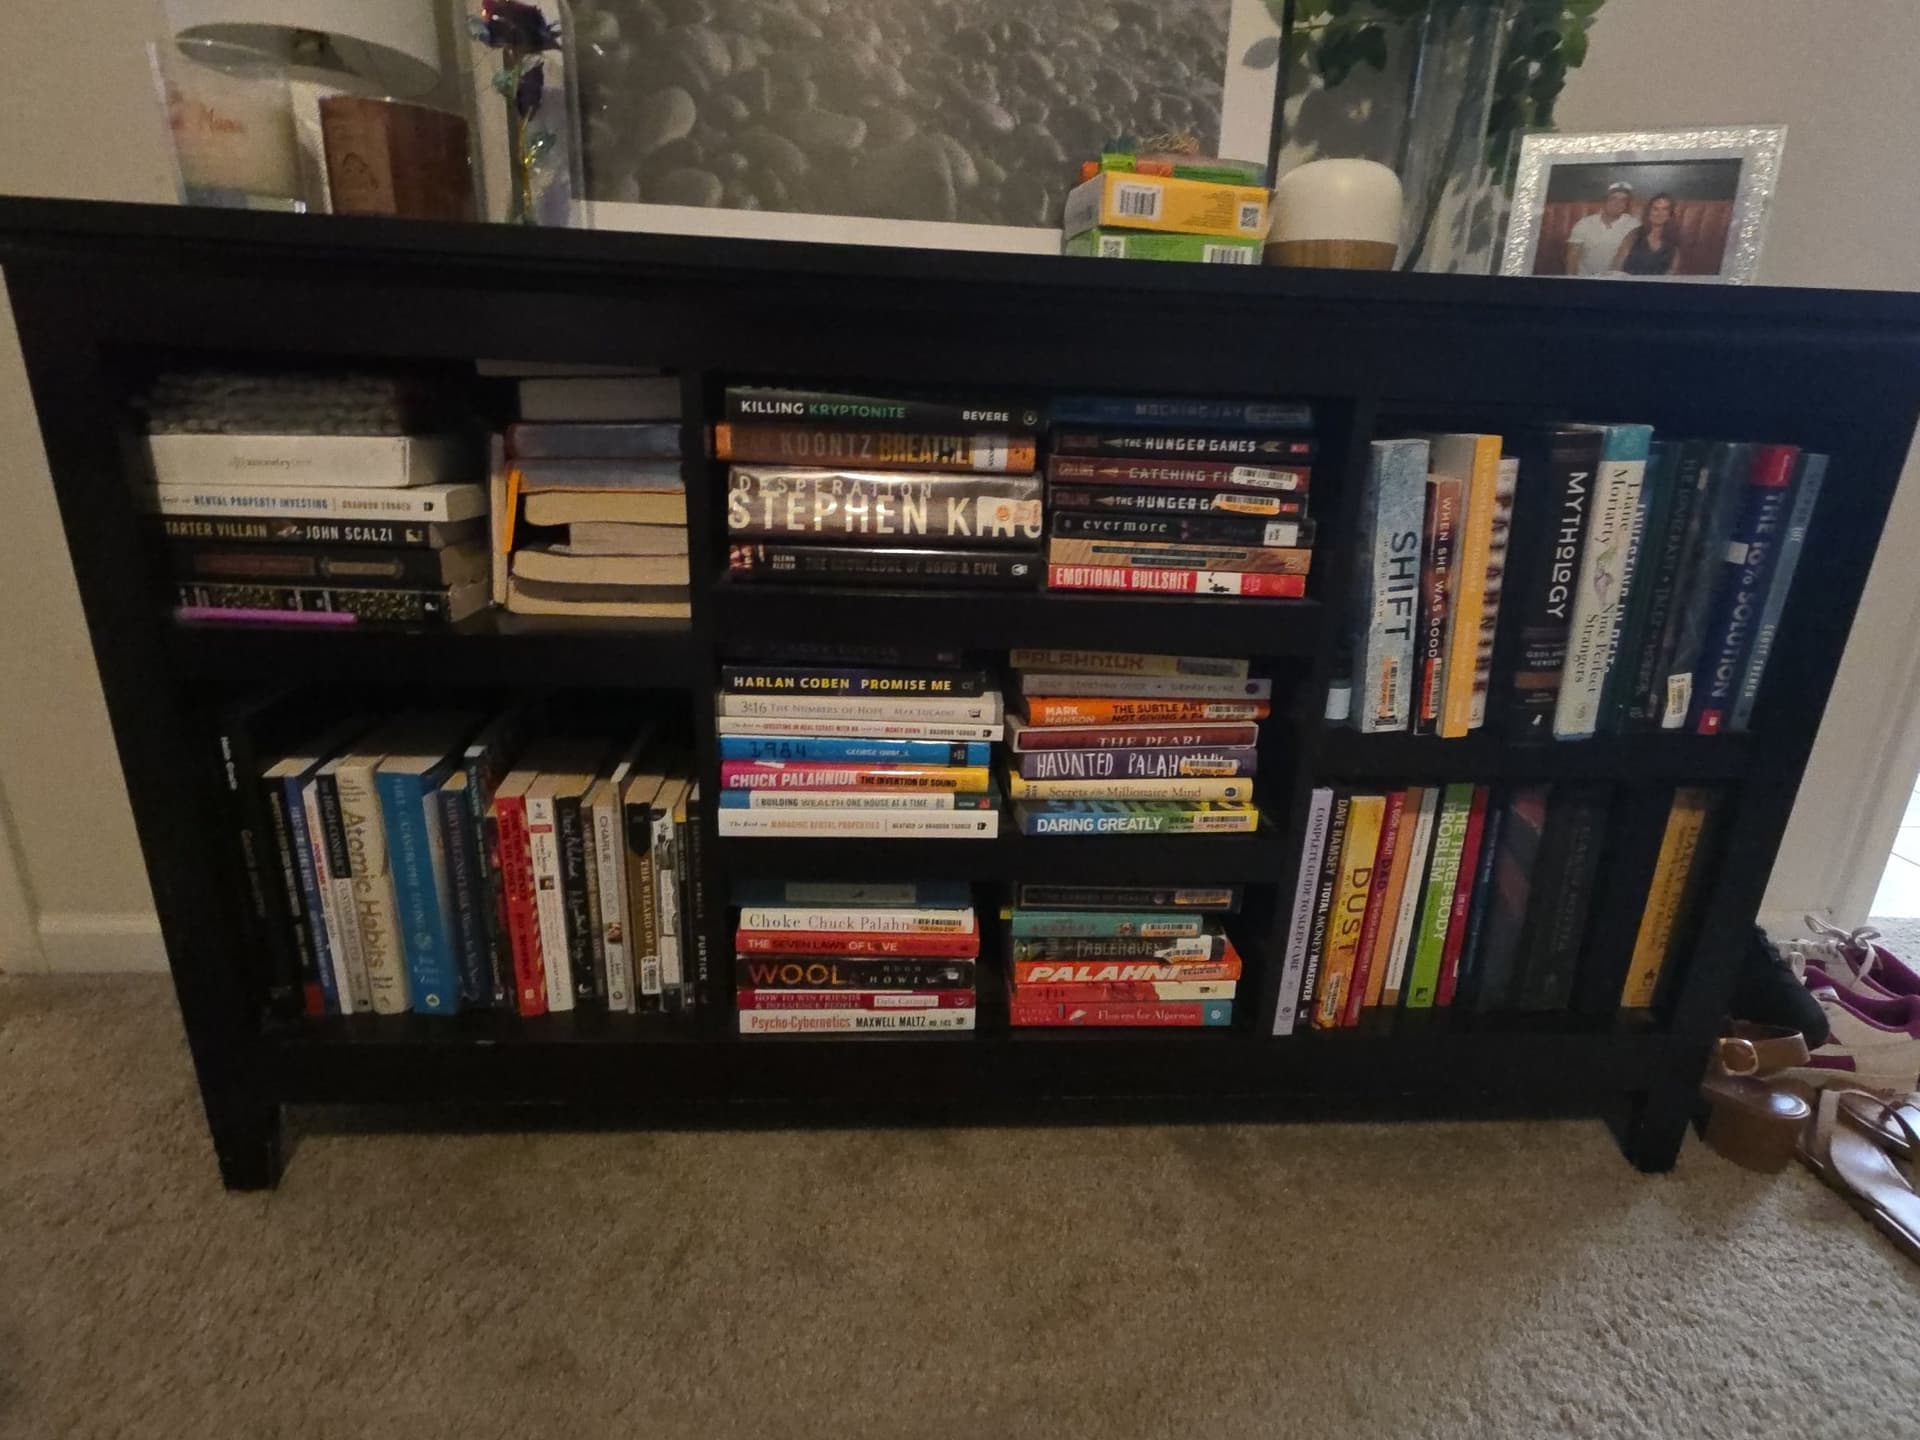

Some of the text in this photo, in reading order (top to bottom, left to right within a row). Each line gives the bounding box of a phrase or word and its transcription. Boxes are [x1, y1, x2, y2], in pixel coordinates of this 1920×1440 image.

[740, 400, 906, 418] KILLING KRYPTONITE
[961, 408, 1010, 423] BEVERE
[780, 433, 873, 459] KOONTZ
[1144, 437, 1209, 452] HUNGER
[1210, 438, 1257, 453] GAMES
[1128, 466, 1207, 482] CATCHING
[727, 487, 928, 536] STEPHEN
[1136, 495, 1198, 510] HUNGER
[1591, 468, 1640, 546] Liane Moriarty
[164, 521, 268, 537] TARTER VILLAIN
[306, 524, 393, 543] JOHN SCALZI
[1082, 518, 1169, 534] evermore
[1544, 471, 1589, 619] MYTHOLOGY
[973, 560, 1000, 576] EVIL
[1428, 496, 1451, 658] WHEN SHE WAS GOOD
[1055, 567, 1191, 591] EMOTIONAL BULLSHIT
[1383, 530, 1417, 641] SHIFT
[1710, 491, 1784, 697] THE 10% SOLUTION
[1570, 604, 1615, 692] Nine Perfect Strangers
[733, 676, 851, 691] HARLAN COBEN
[860, 678, 952, 692] PROMISE ME
[740, 700, 768, 715] 3:16
[1045, 706, 1080, 715] MARK
[1112, 704, 1134, 714] THE
[1136, 704, 1179, 714] SUBTLE
[1111, 713, 1190, 723] NOT GIVING A
[750, 742, 808, 758] 1984
[845, 748, 878, 757] GEORGE
[1035, 752, 1114, 777] HAUNTED
[1127, 752, 1224, 777] PALAH
[729, 771, 857, 788] CHUCK PALAHNIUK
[860, 776, 957, 788] THE INVENTION OF SOUND
[1049, 786, 1088, 798] Secrets
[1106, 786, 1168, 798] Millionaire
[1171, 786, 1202, 798] Mind
[761, 798, 799, 807] BUILDING
[801, 798, 845, 808] WEALTH
[846, 798, 860, 807] ONE
[861, 798, 890, 808] HOUSE
[890, 798, 900, 807] AT
[909, 798, 928, 808] TIME
[1036, 816, 1095, 833] DARING
[1096, 815, 1165, 832] GREATLY
[598, 815, 612, 864] CHARLIE
[1324, 798, 1348, 876] DAVE RAMSEY
[1428, 801, 1457, 882] PROBLEM
[342, 809, 390, 968] Atomic Habits
[1288, 807, 1325, 971] COMPLETE GUIDE TO SLEEP CARE
[639, 859, 653, 944] THE WIZARD OF
[1336, 867, 1371, 955] DUST
[749, 913, 910, 932] Choke Chuck Palahn
[747, 939, 866, 951] THE SEVEN LAWS OF
[1301, 885, 1332, 1001] TOTAL MONEY MAKEOVER
[748, 963, 842, 986] WOOL
[751, 1015, 850, 1031] Psycho-Cybernetics
[855, 1015, 927, 1028] MAXWELL MALTZ
